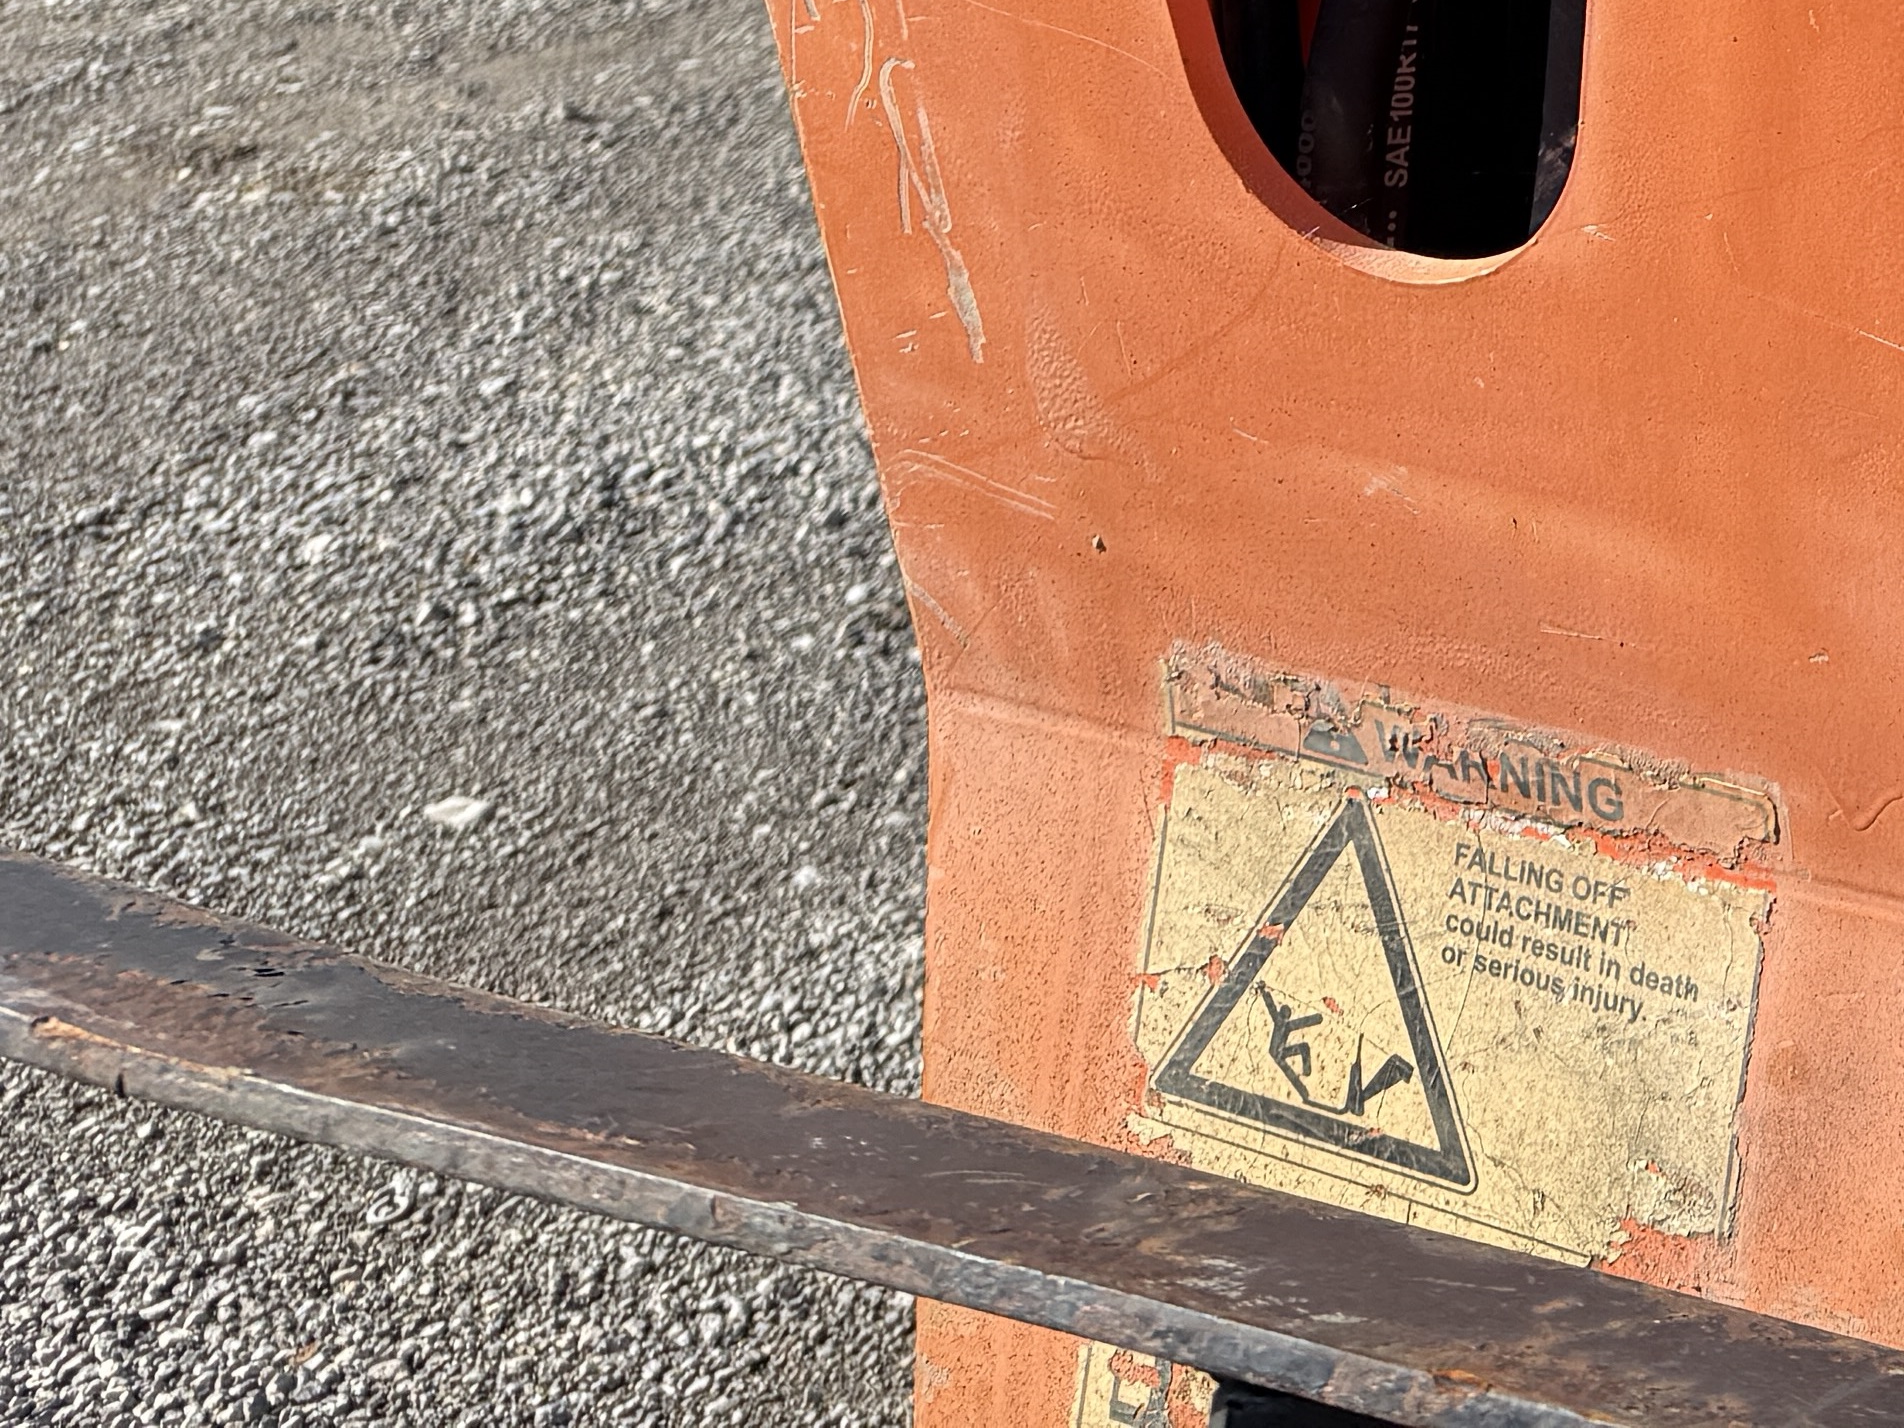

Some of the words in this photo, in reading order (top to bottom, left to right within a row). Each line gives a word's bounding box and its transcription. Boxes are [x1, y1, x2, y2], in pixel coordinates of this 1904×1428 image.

[1448, 877, 1627, 947] ATTACHMENT
[1454, 842, 1564, 893] FALLING
[1572, 875, 1631, 908] OFF
[1441, 944, 1467, 967] or
[1474, 954, 1566, 995] serious
[1572, 975, 1647, 1024] injury.
[1445, 913, 1514, 948] could
[1521, 932, 1592, 972] result
[1600, 951, 1622, 981] in
[1629, 961, 1700, 1002] death
